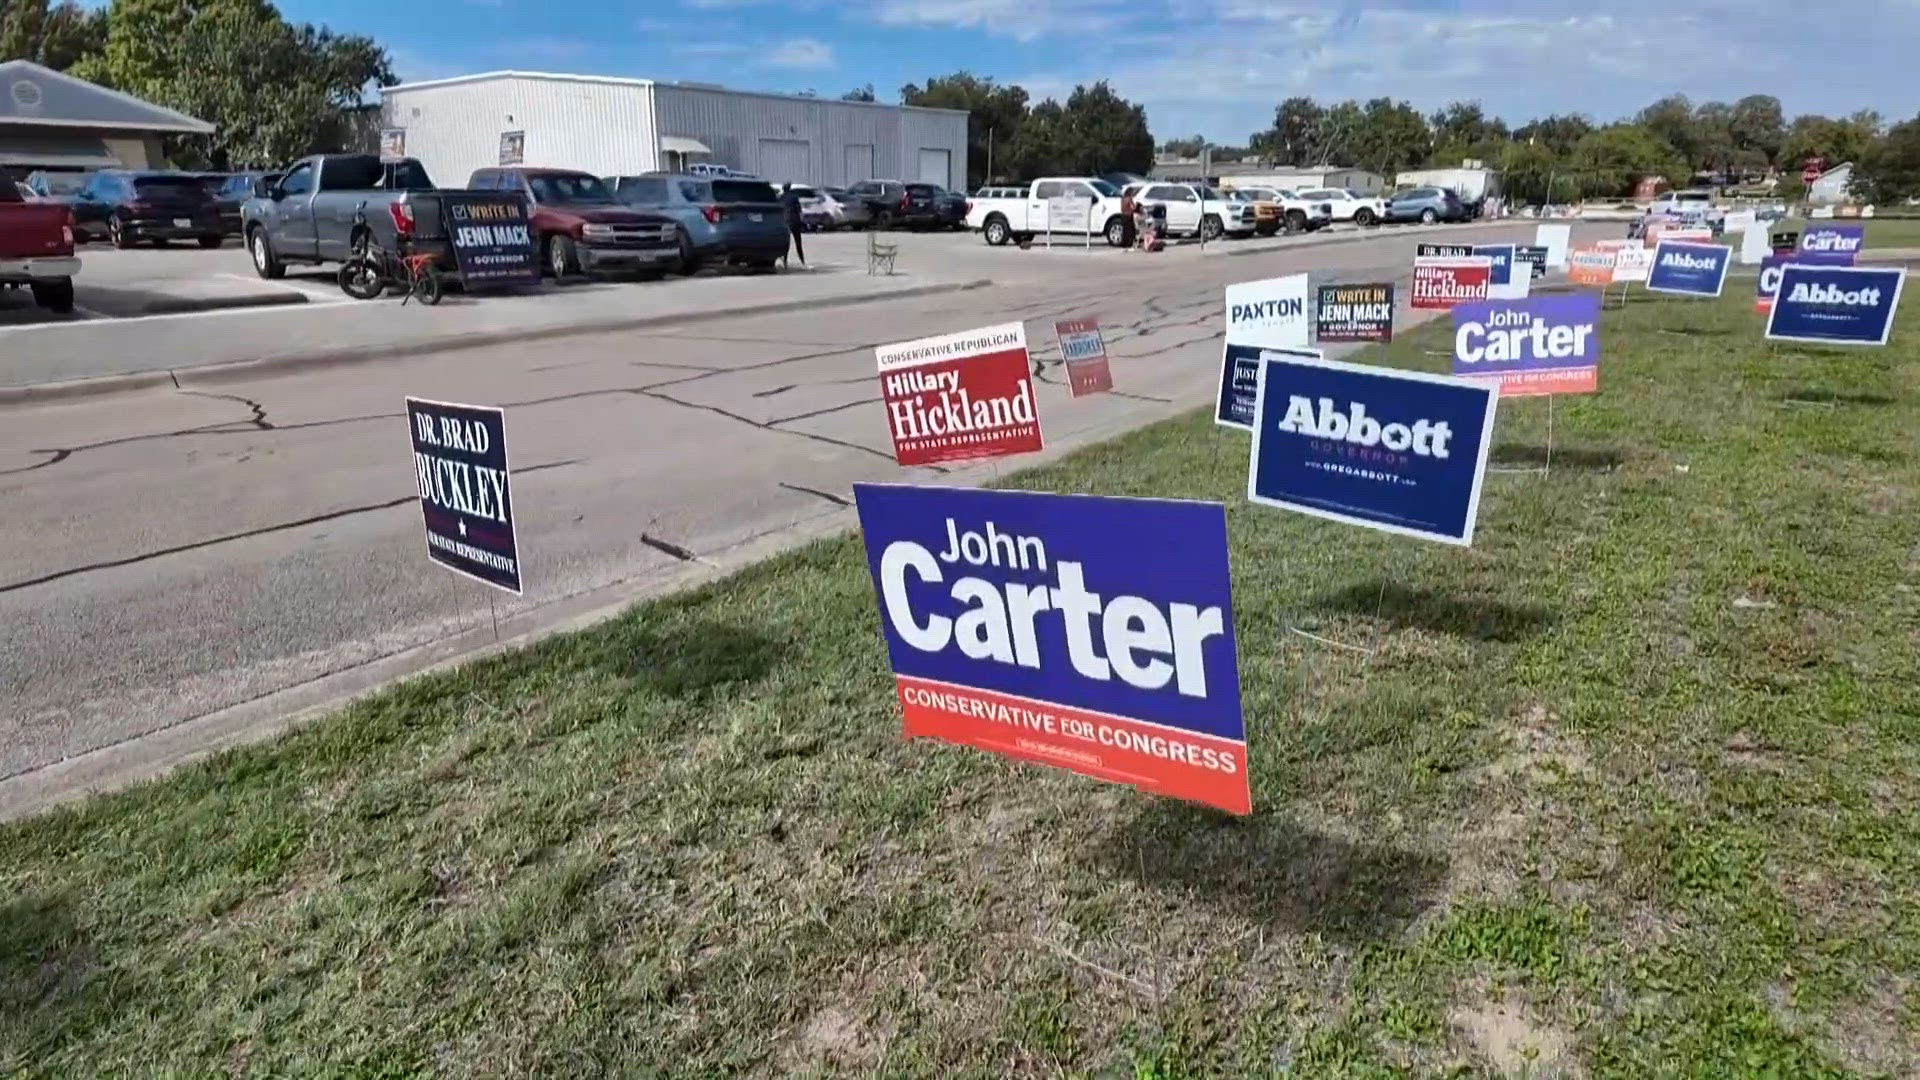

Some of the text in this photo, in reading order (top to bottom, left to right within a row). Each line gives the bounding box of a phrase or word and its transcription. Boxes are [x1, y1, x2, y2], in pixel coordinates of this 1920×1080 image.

[467, 205, 520, 219] WRITE IN
[456, 225, 531, 247] JENN MACK
[1802, 234, 1861, 250] Carter
[1660, 252, 1717, 270] Abbott
[1416, 268, 1455, 281] Hillary
[1337, 289, 1386, 303] WRITE IN
[1413, 279, 1487, 298] Hickland
[1787, 282, 1881, 306] Abbott
[1232, 297, 1302, 323] PAXTON
[1319, 303, 1390, 321] JENN MACK
[1485, 308, 1530, 327] John
[881, 332, 1018, 365] CONSERVATIVE REPUBLICAN
[1455, 318, 1593, 363] Carter
[886, 369, 959, 397] Hillary
[889, 379, 1036, 440] Hickland
[415, 412, 489, 454] DR. BRAD
[899, 427, 1034, 451] FOR STATE REPRESENTATIVE
[1278, 395, 1452, 459] Abbott
[415, 452, 508, 522] BUCKLEY
[939, 517, 1048, 572] John
[880, 540, 1224, 698] Carter
[904, 687, 1056, 734] CONSERVATIVE
[1060, 718, 1095, 739] FOR
[1098, 725, 1237, 774] CONGRESS
